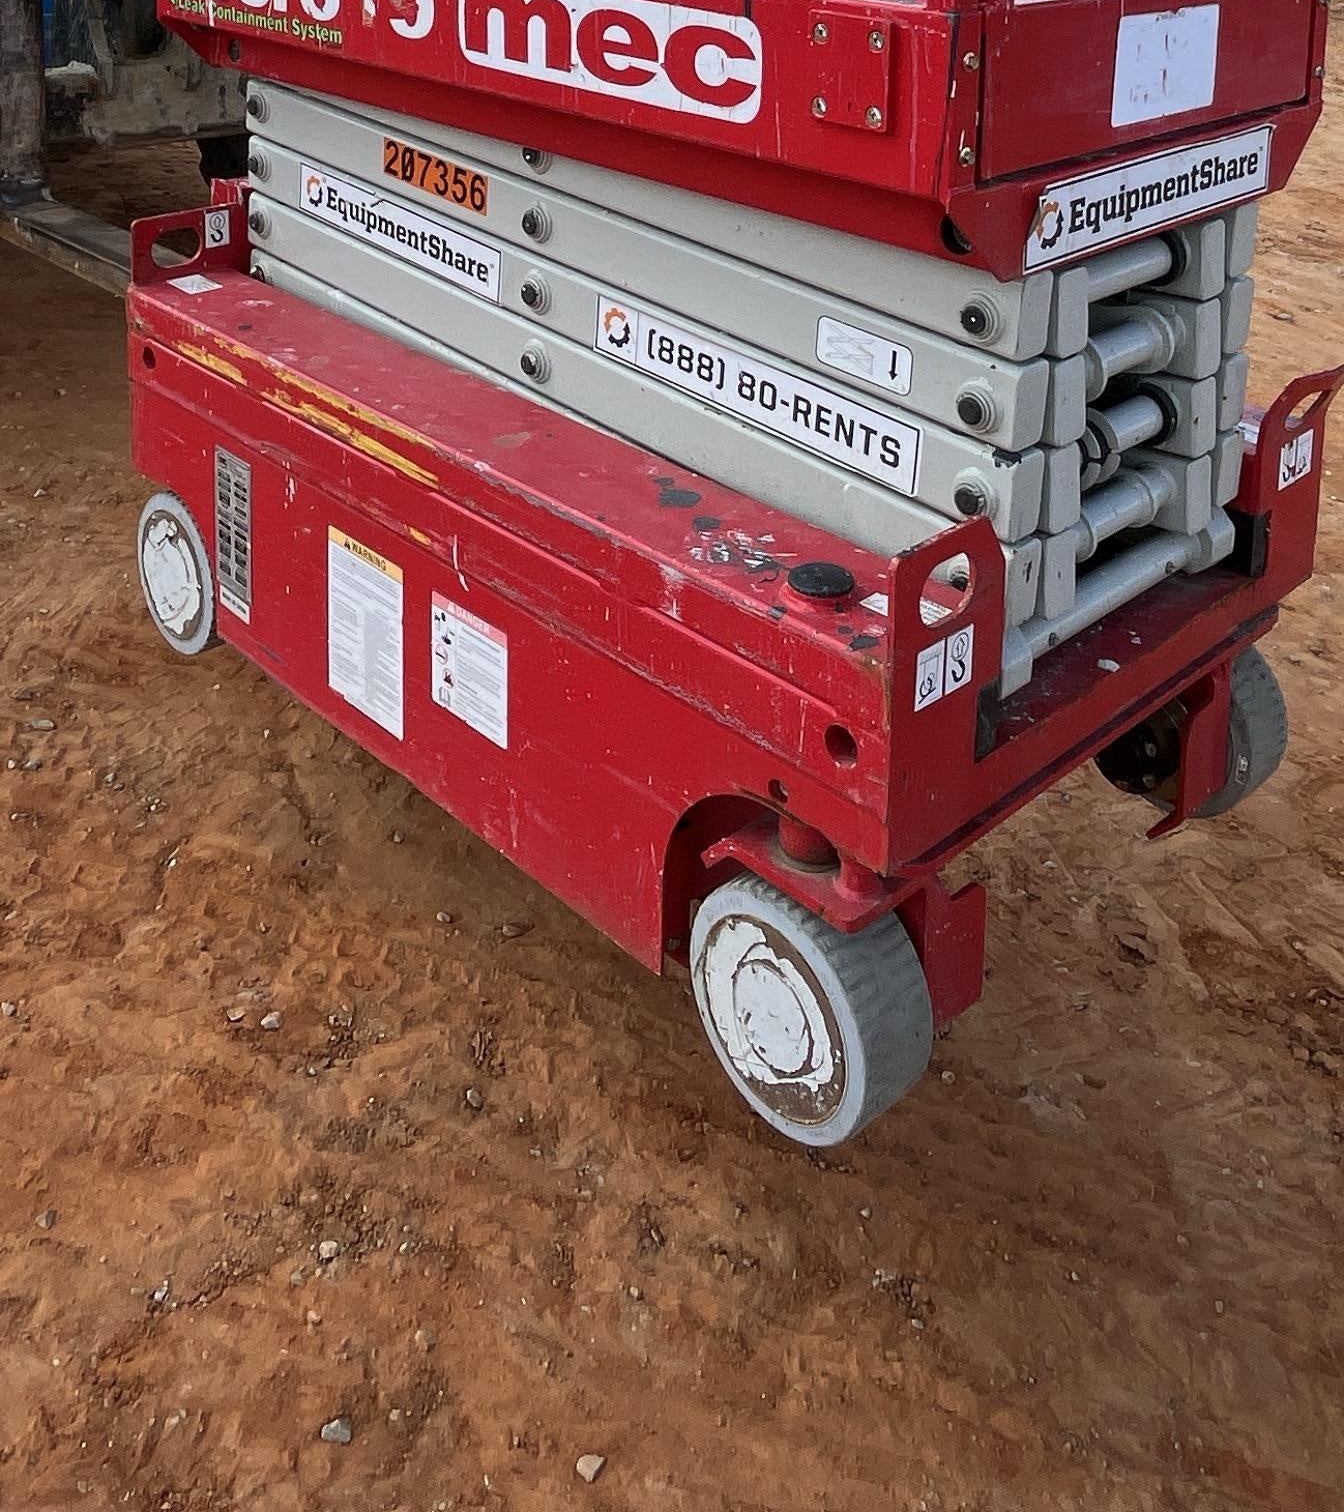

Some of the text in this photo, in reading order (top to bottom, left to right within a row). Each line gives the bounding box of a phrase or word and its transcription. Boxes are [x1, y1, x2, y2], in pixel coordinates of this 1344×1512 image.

[291, 18, 343, 45] System
[383, 140, 486, 212] 207356
[1067, 150, 1259, 234] EquipmentShare
[326, 187, 490, 283] EquipmentShare
[647, 328, 902, 469] (888) 80-RENTS
[351, 541, 387, 572] WARNING
